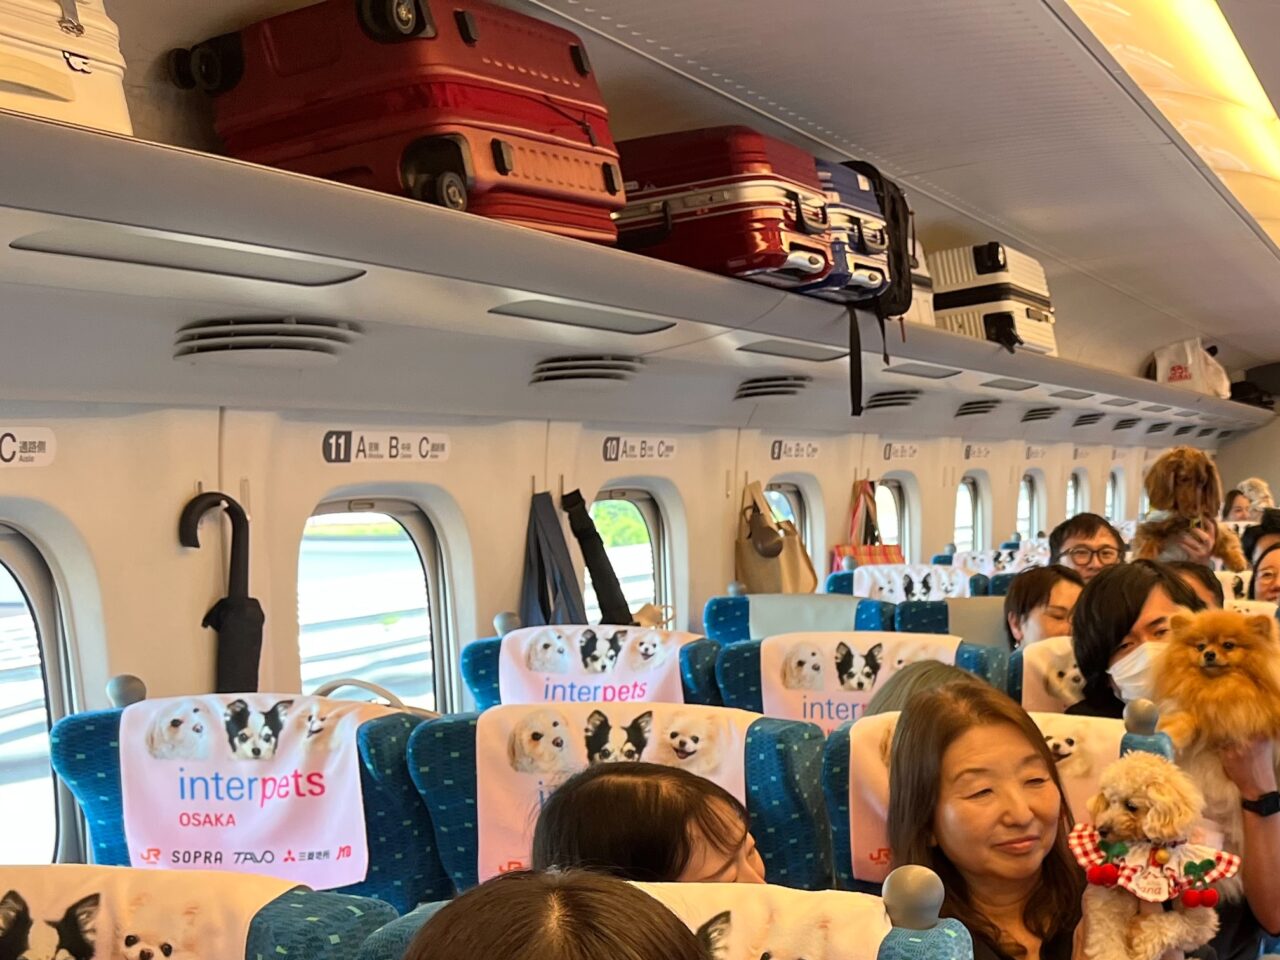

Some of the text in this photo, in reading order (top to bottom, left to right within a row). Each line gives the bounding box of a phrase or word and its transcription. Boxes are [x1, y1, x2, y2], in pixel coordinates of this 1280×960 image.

[0, 433, 16, 463] C
[329, 435, 346, 460] 11
[355, 436, 367, 459] A
[389, 436, 399, 459] B
[419, 436, 430, 459] C
[606, 440, 617, 459] 10
[621, 440, 627, 458] A
[640, 440, 647, 458] B
[658, 440, 664, 458] C
[544, 677, 647, 701] interpets
[803, 695, 867, 720] inter
[179, 768, 326, 808] interpets
[179, 812, 236, 827] OSAKA
[141, 848, 161, 861] JR
[171, 850, 223, 864] SOPRA
[233, 850, 275, 864] TAVO
